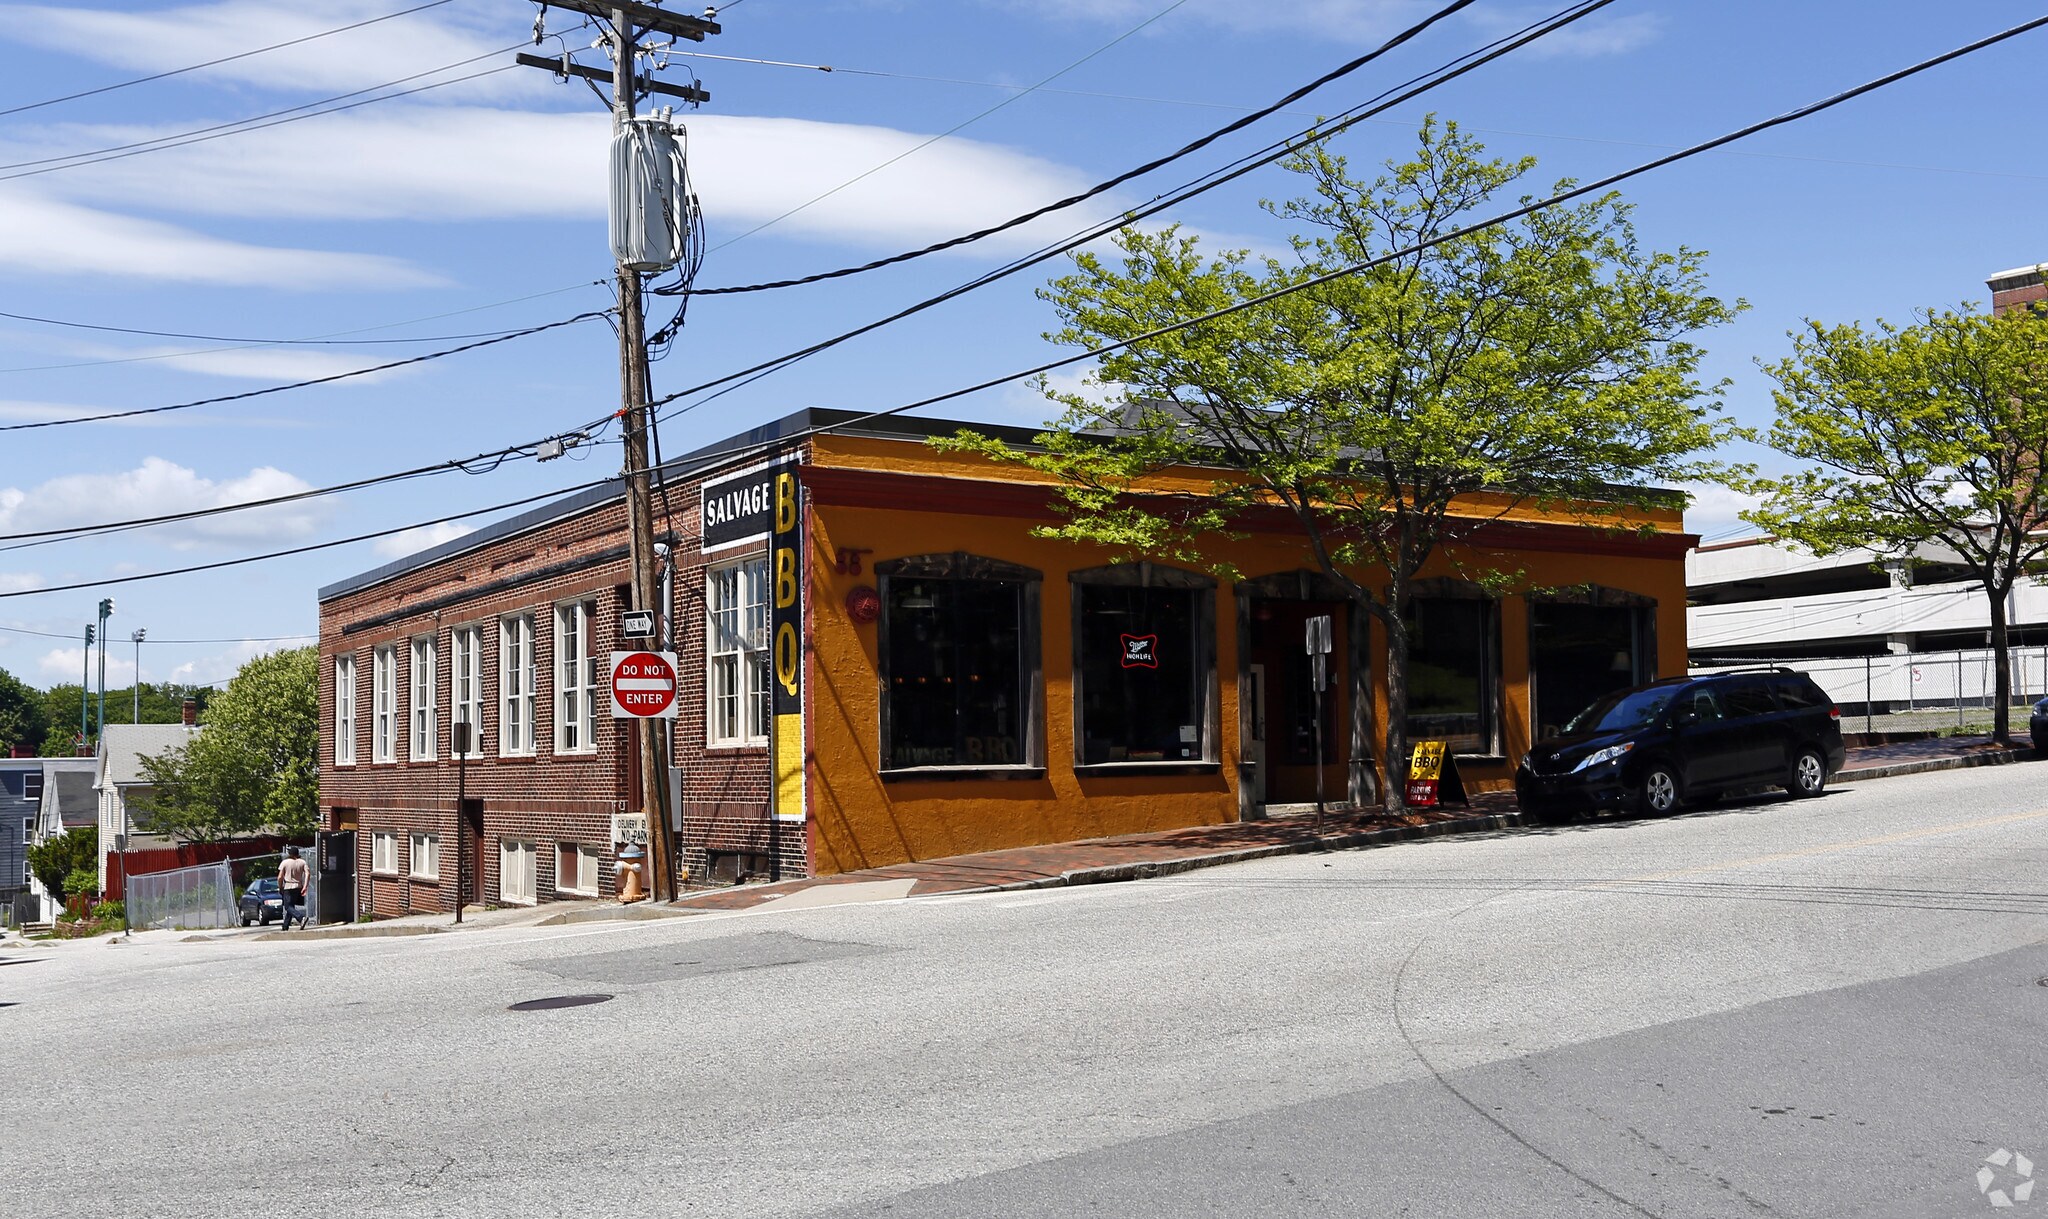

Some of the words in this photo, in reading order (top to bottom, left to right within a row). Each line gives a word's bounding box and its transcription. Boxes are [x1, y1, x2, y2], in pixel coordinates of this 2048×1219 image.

[706, 482, 770, 527] SALVAGE
[775, 472, 797, 697] BBQ
[626, 620, 637, 630] ONE
[638, 619, 647, 629] WAY
[622, 665, 638, 676] DO
[644, 665, 666, 676] NOT
[626, 693, 663, 704] ENTER
[1414, 756, 1440, 770] BBQ
[617, 819, 638, 829] DELIVERY
[621, 829, 631, 841] NO
